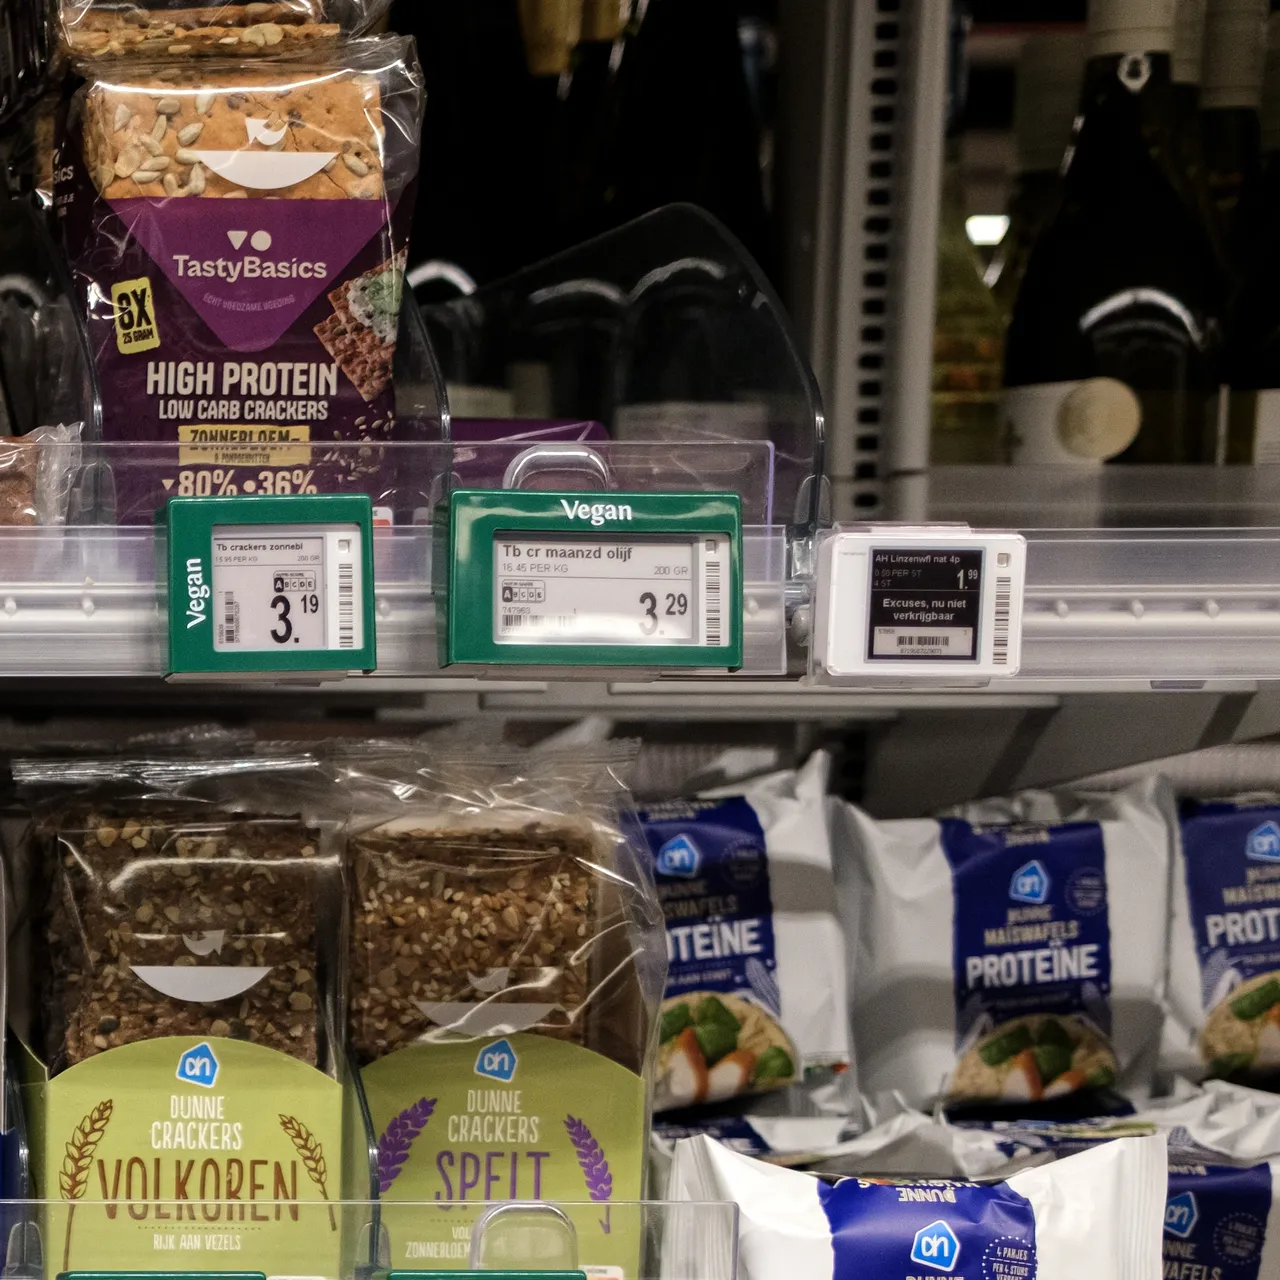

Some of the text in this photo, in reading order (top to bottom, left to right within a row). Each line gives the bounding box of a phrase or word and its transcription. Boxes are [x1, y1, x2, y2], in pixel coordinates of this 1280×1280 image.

[173, 255, 328, 283] TastyBasics
[146, 361, 338, 397] HIGH PROTEIN
[159, 400, 329, 421] LOW CARB CRACKERS
[178, 470, 317, 496] 80% 36%
[560, 499, 632, 526] Vegan
[502, 544, 633, 562] Tb cr maanzd olijf
[875, 555, 887, 563] AH
[933, 555, 947, 564] nat
[949, 555, 960, 565] 4p
[665, 592, 688, 616] 29
[883, 598, 966, 609] Excuses, nu niet
[893, 610, 955, 622] verkrijgbaar
[965, 938, 1101, 990] PROTEÏNE
[169, 1096, 226, 1120] DUNNE
[150, 1122, 242, 1151] CRACKERS
[96, 1157, 300, 1222] VOLKOREN
[153, 1233, 241, 1251] RIJK AAN VEZELS
